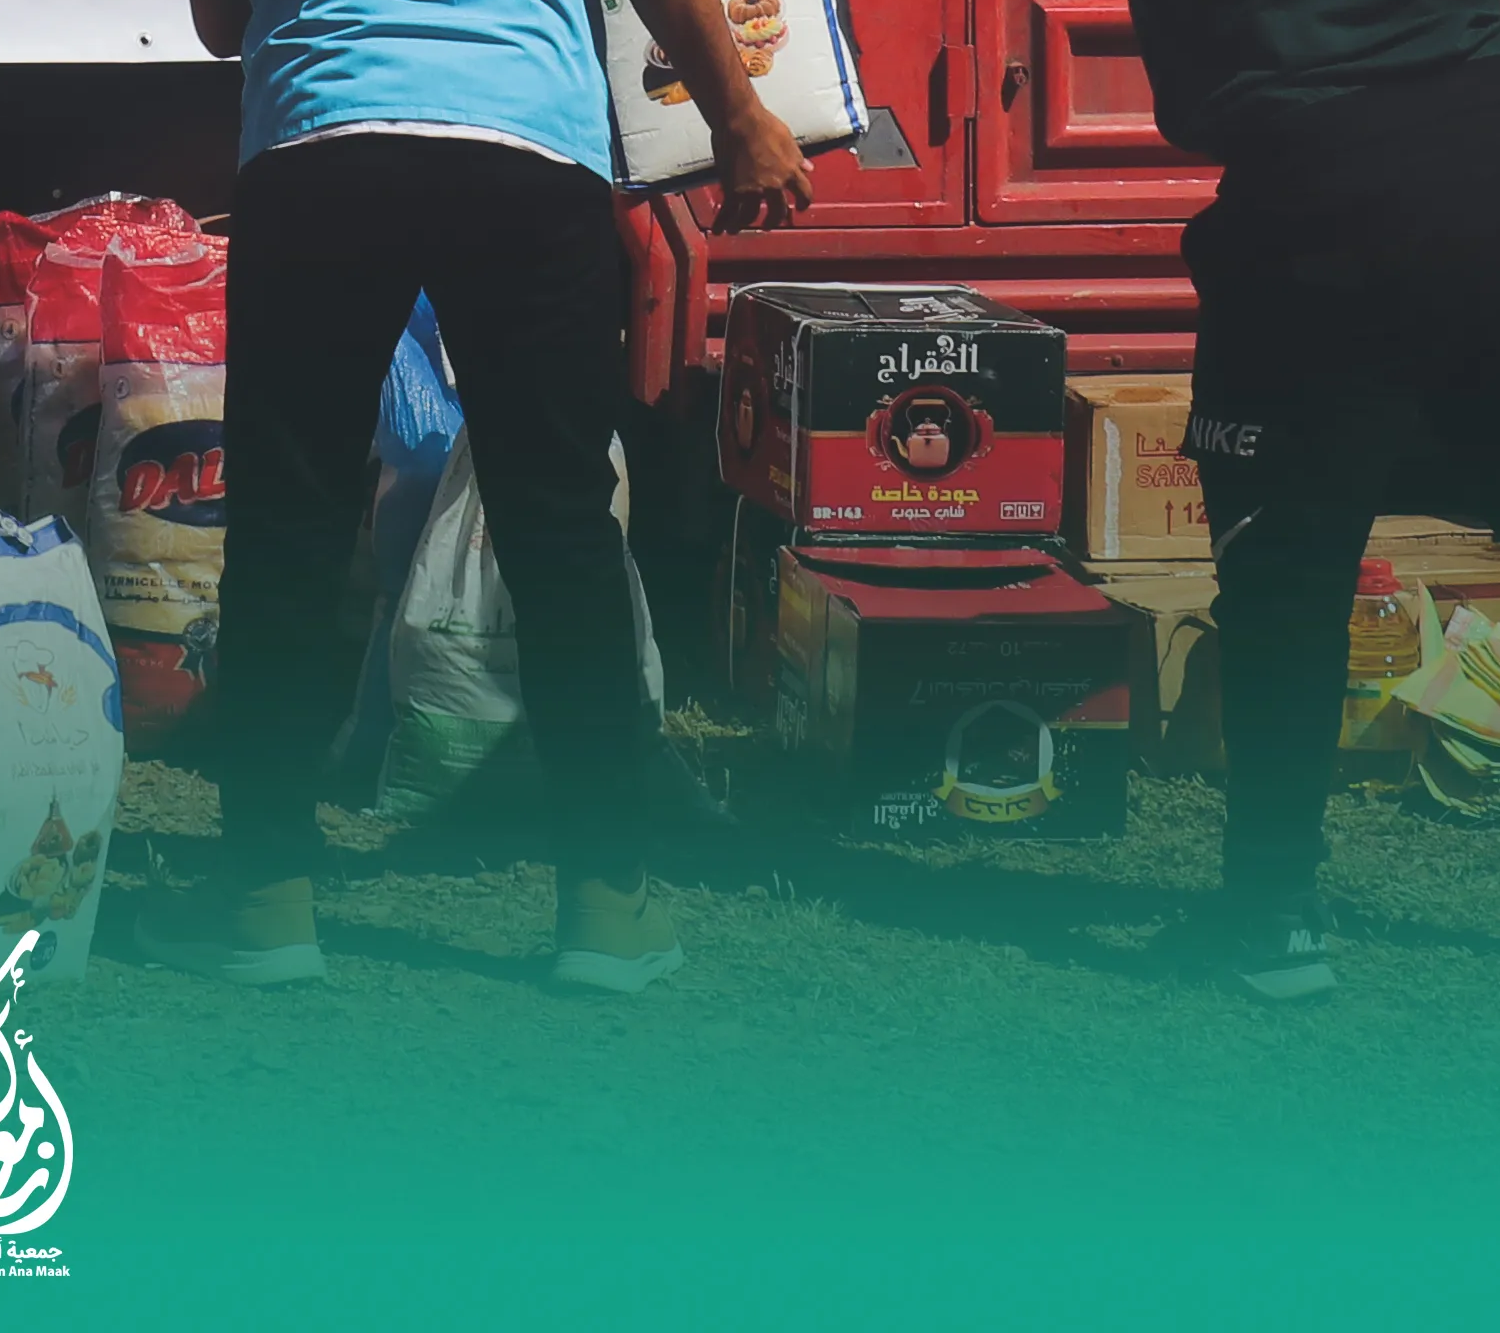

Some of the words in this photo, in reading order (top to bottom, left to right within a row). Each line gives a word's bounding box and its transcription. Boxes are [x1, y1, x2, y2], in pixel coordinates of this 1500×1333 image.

[1190, 415, 1264, 456] NIKE
[117, 447, 226, 513] DAL
[1136, 463, 1201, 488] SARA
[1183, 501, 1209, 525] 12
[103, 574, 185, 587] VERMICELLE
[191, 579, 220, 590] MOY
